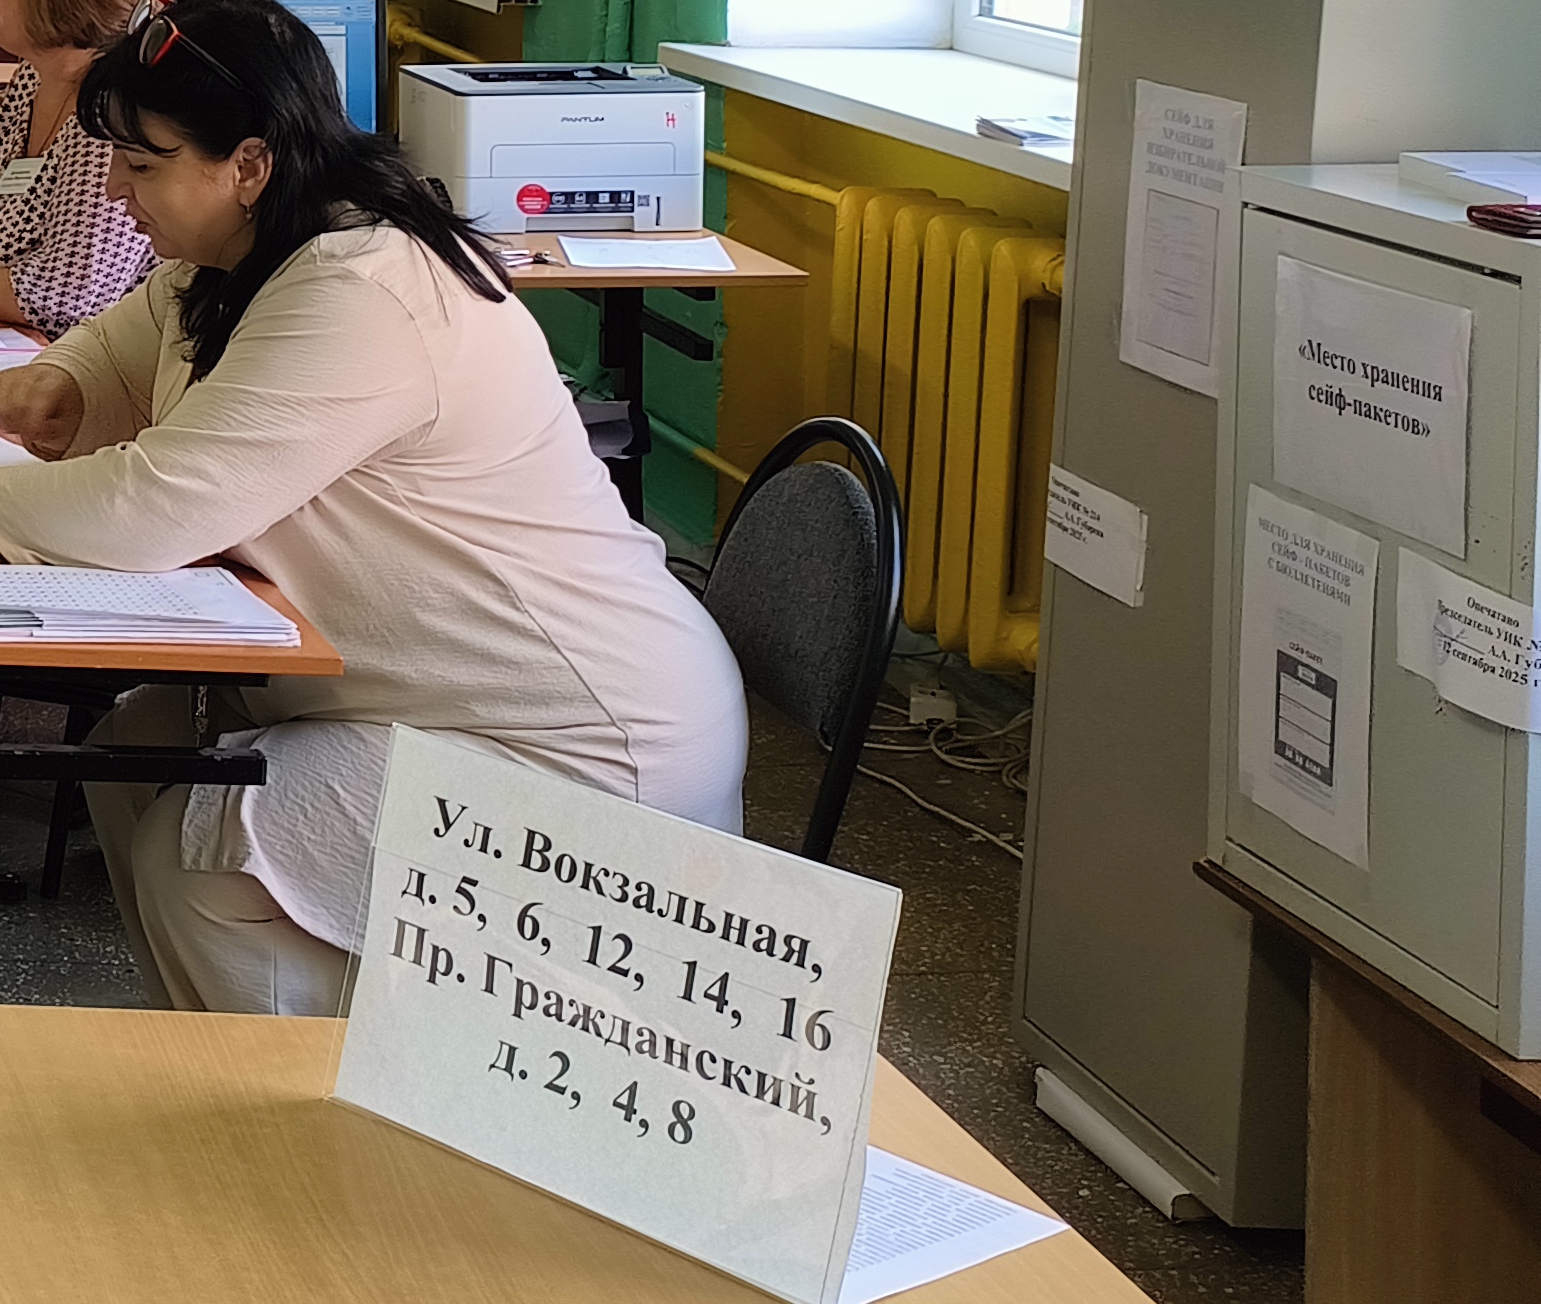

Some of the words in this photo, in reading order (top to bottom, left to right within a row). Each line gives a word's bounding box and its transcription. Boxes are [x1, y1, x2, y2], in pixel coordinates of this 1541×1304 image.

[1298, 339, 1356, 375] «Место
[1360, 362, 1443, 402] хранения
[1308, 383, 1431, 438] сейф-пакетов»
[1467, 596, 1520, 628] Опечатано
[1496, 627, 1524, 648] УИК
[1498, 666, 1528, 686] 2025
[432, 795, 504, 860] Ул.
[518, 827, 825, 983] Вокзальная,
[401, 867, 437, 905] д.
[452, 875, 488, 931] 5,
[515, 901, 552, 955] 6,
[582, 924, 646, 991] 12,
[677, 959, 743, 1029] 14,
[777, 997, 835, 1052] 16
[390, 917, 466, 984] Пр.
[480, 951, 834, 1136] Гражданский,
[488, 1040, 528, 1081] д.
[544, 1050, 582, 1108] 2,
[613, 1080, 650, 1137] 4,
[666, 1099, 697, 1145] 8
